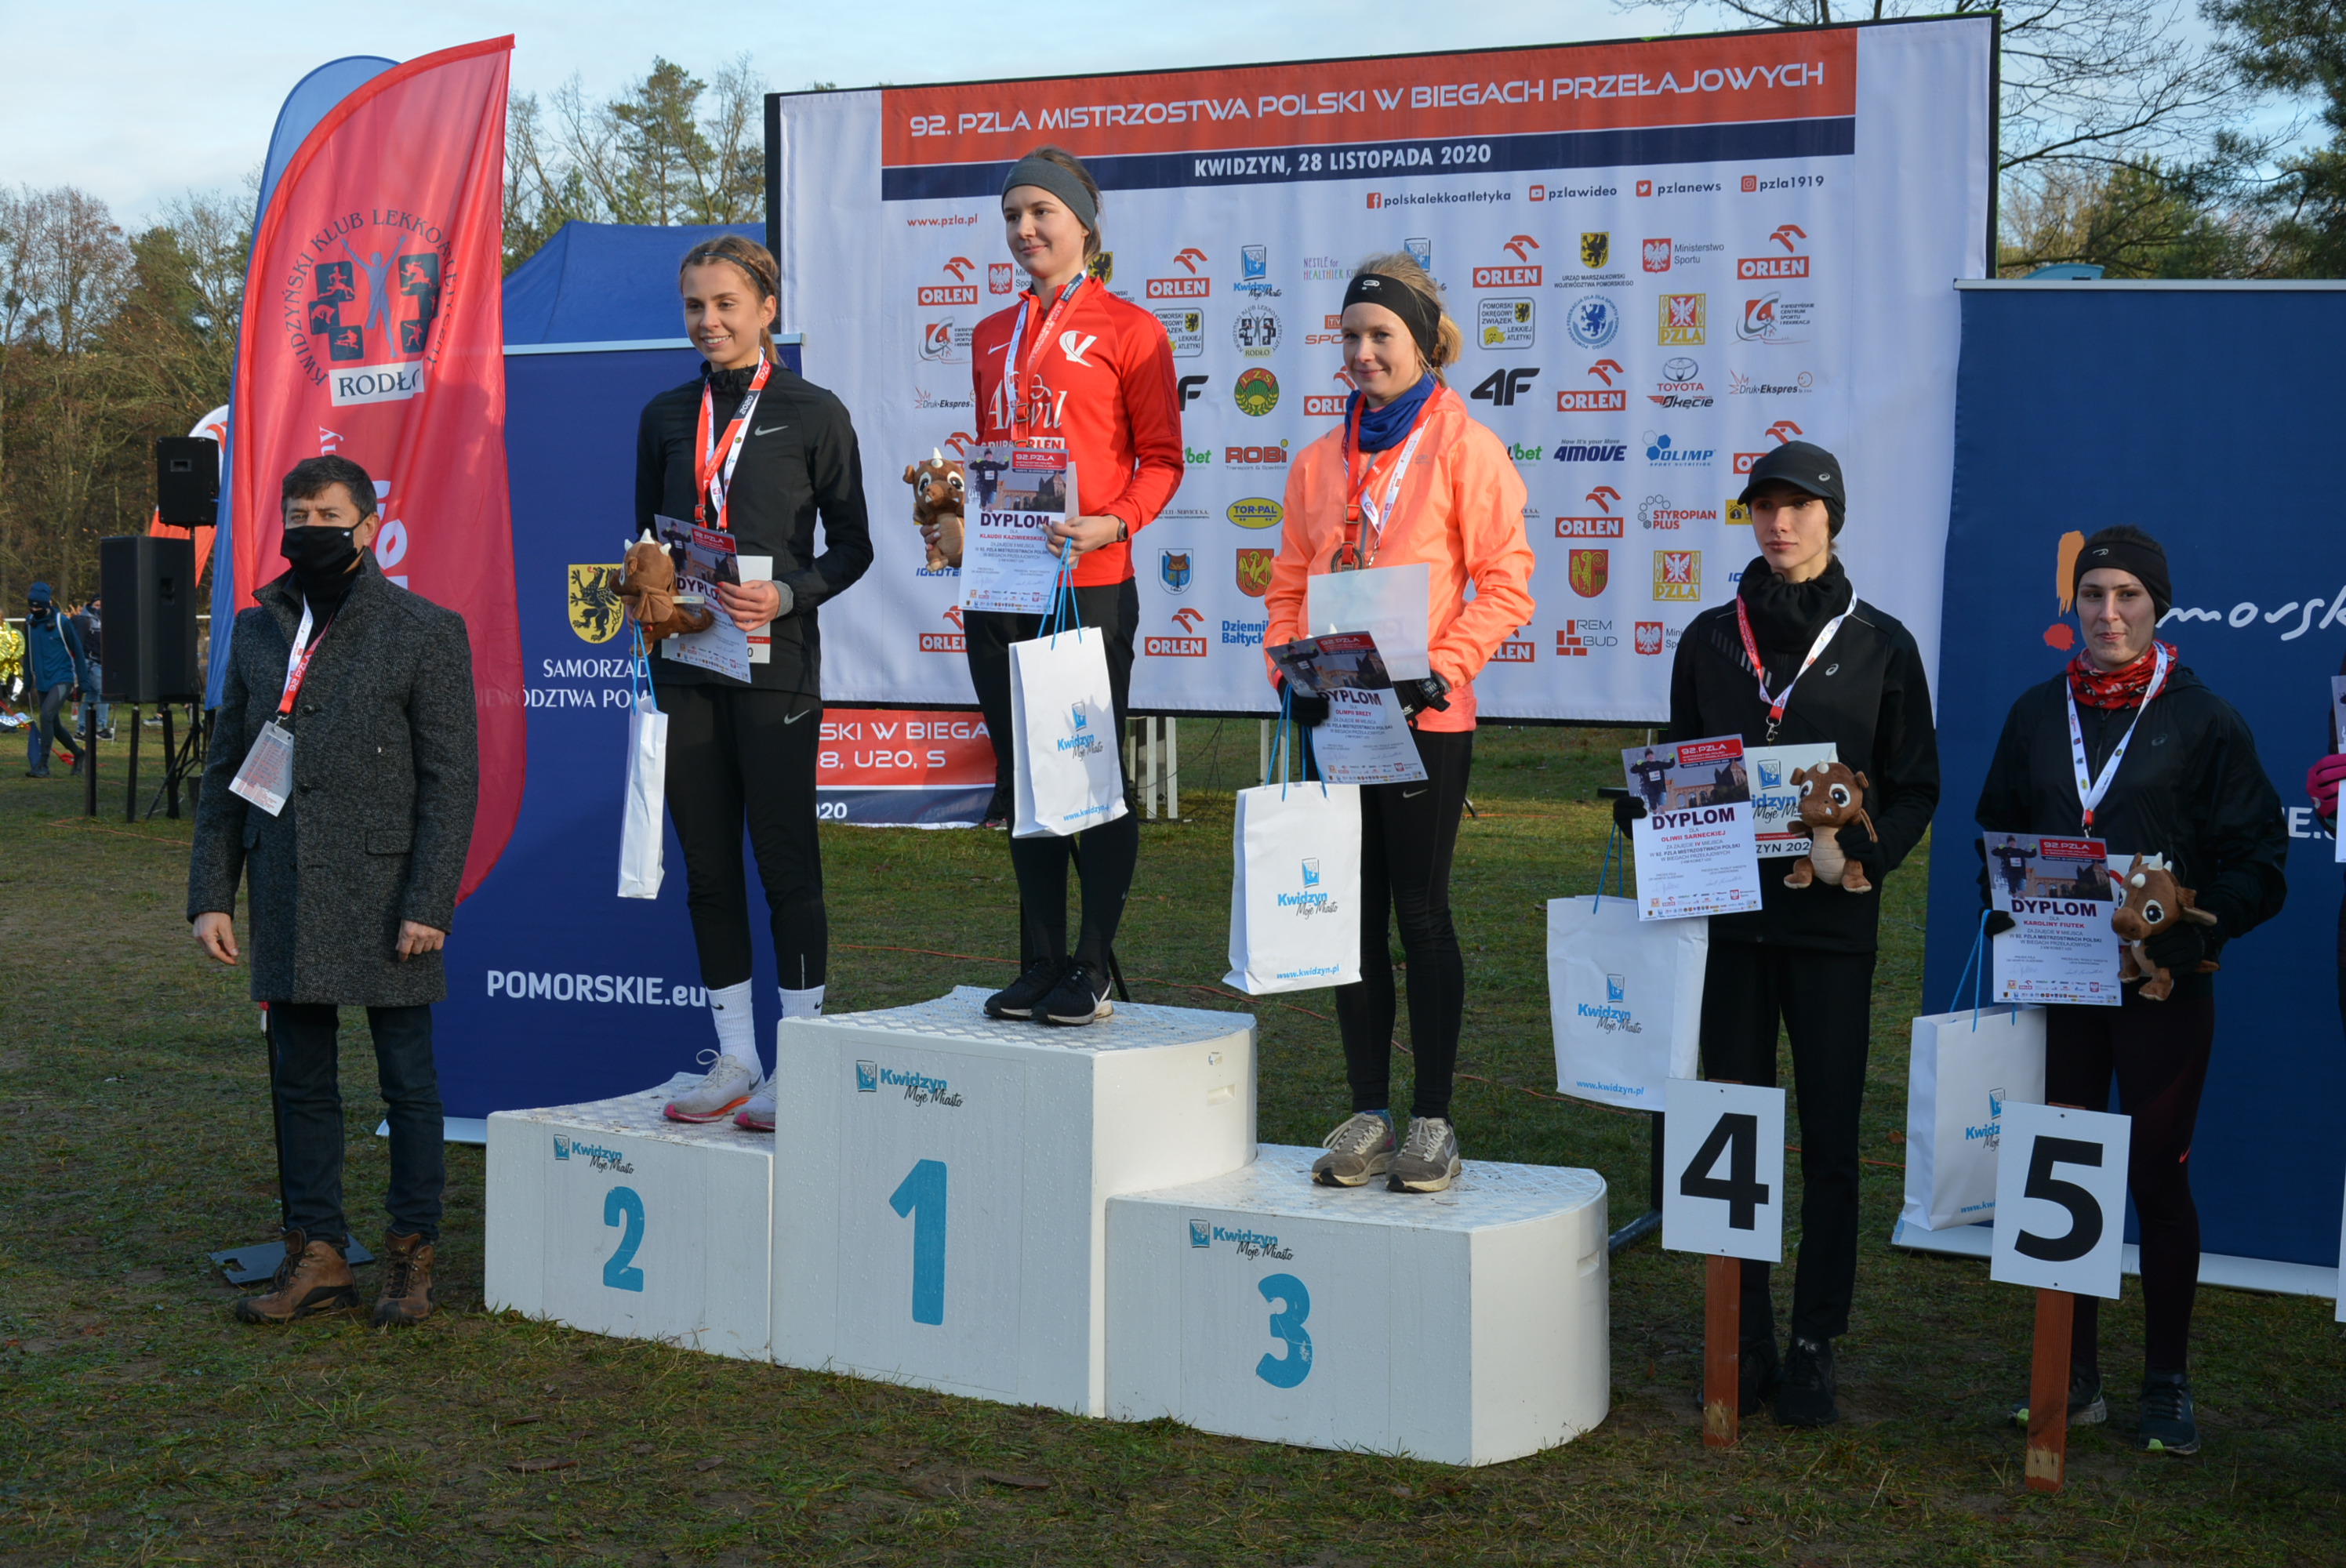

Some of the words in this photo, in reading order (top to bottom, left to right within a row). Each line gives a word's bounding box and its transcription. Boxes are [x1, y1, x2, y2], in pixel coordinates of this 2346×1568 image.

[910, 115, 951, 136] 92.
[958, 111, 1031, 134] PZLA
[1038, 98, 1251, 130] MISTRZOSTWA
[1258, 90, 1364, 118] POLSKI
[1373, 88, 1404, 111] W
[1411, 79, 1544, 109] BIEGACH
[1552, 62, 1824, 100] PRZEŁAJOWYCH
[1195, 155, 1291, 177] KWIDZYN,
[1298, 153, 1322, 172] 28
[1331, 147, 1434, 170] LISTOPADA
[1441, 143, 1491, 165] 2020
[1658, 181, 1721, 197] pzlanews
[1760, 175, 1824, 192] pzla1919
[1384, 190, 1511, 209] polskalekkoatletyka
[1549, 186, 1617, 201] pzlawideo
[907, 213, 978, 227] www.pzla.pl
[310, 212, 364, 252] KLUB
[1674, 243, 1724, 253] Ministerstwo
[1674, 256, 1701, 266] Sportu
[1741, 260, 1805, 277] ORLEN
[1304, 270, 1344, 280] HEALTHIER
[1476, 268, 1538, 285] ORLEN
[1149, 281, 1205, 296] ORLEN
[1233, 282, 1272, 292] Kwidzyn
[921, 289, 974, 303] ORLEN
[1305, 335, 1344, 345] SPO
[1661, 328, 1702, 343] PZLA
[1242, 371, 1272, 384] LZS
[1470, 368, 1540, 406] 4F
[1657, 383, 1705, 392] TOYOTA
[739, 395, 754, 415] 2020
[1560, 394, 1621, 409] ORLEN
[1553, 445, 1627, 462] 4MOVE
[1661, 450, 1713, 461] OLIMP
[981, 513, 1050, 528] DYPLOM
[1654, 510, 1716, 520] STYROPIAN
[1559, 520, 1619, 535] ORLEN
[1654, 521, 1680, 530] PLUS
[677, 575, 722, 601] DYPLO
[1655, 585, 1698, 599] PZLA
[1577, 619, 1612, 630] REM
[1148, 640, 1203, 655] ORLEN
[1222, 633, 1265, 647] Bałtyck
[1583, 636, 1618, 647] BUD
[1498, 645, 1528, 659] LEN
[819, 722, 861, 740] SKI
[870, 722, 898, 740] W
[906, 721, 990, 739] BIEGA
[1057, 732, 1095, 752] Kwidzyn
[855, 750, 917, 769] U20,
[927, 750, 946, 768] S
[1752, 793, 1796, 811] idzyn
[1652, 807, 1735, 830] DYPLOM
[1684, 830, 1727, 840] SARNECKIEJ
[1277, 891, 1327, 907] Kwidzyn
[1296, 902, 1314, 920] Moje
[1316, 900, 1338, 914] Miasto
[2011, 899, 2097, 917] DYPLOM
[1276, 964, 1339, 979] www.kwidzyn.pl
[488, 970, 706, 1007] POMORSKIE.eu
[1578, 1003, 1631, 1023] Kwidzyn
[1596, 1016, 1616, 1035] Moje
[1618, 1018, 1642, 1034] Miasto
[880, 1069, 947, 1094] Kwidzyn
[1576, 1079, 1644, 1096] www.kwidzyn.pl
[904, 1084, 928, 1107] Moje
[931, 1088, 964, 1107] Miasto
[1966, 1123, 2000, 1141] Kwidz
[572, 1142, 623, 1162] Kwidzyn
[590, 1156, 608, 1174] Moje
[609, 1158, 635, 1174] Miasto
[1680, 1112, 1769, 1231] 4
[2014, 1134, 2103, 1262] 5
[602, 1185, 645, 1293] 2
[888, 1159, 947, 1326] 1
[1213, 1227, 1278, 1248] Kwidzyn
[1236, 1241, 1259, 1261] Moje
[1262, 1243, 1294, 1261] Miasto
[1255, 1272, 1313, 1388] 3
